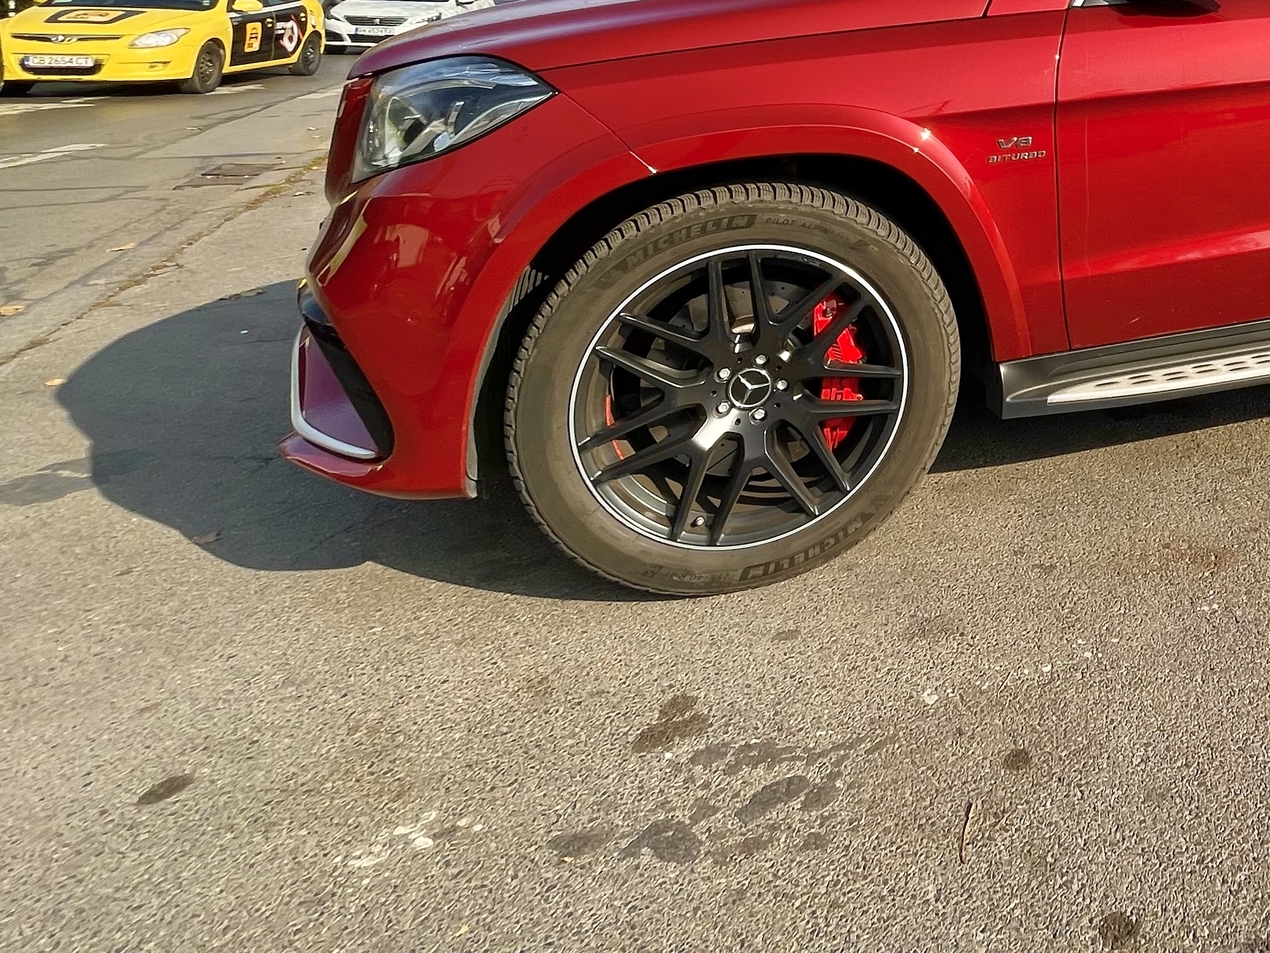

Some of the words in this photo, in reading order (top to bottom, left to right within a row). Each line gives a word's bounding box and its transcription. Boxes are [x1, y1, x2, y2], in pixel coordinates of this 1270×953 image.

[48, 57, 74, 65] 2654
[997, 136, 1032, 149] V8
[987, 150, 1046, 163] BITURBO
[626, 215, 751, 270] MICHELIN
[764, 216, 797, 226] PILOT
[747, 515, 865, 581] MICHELIN
